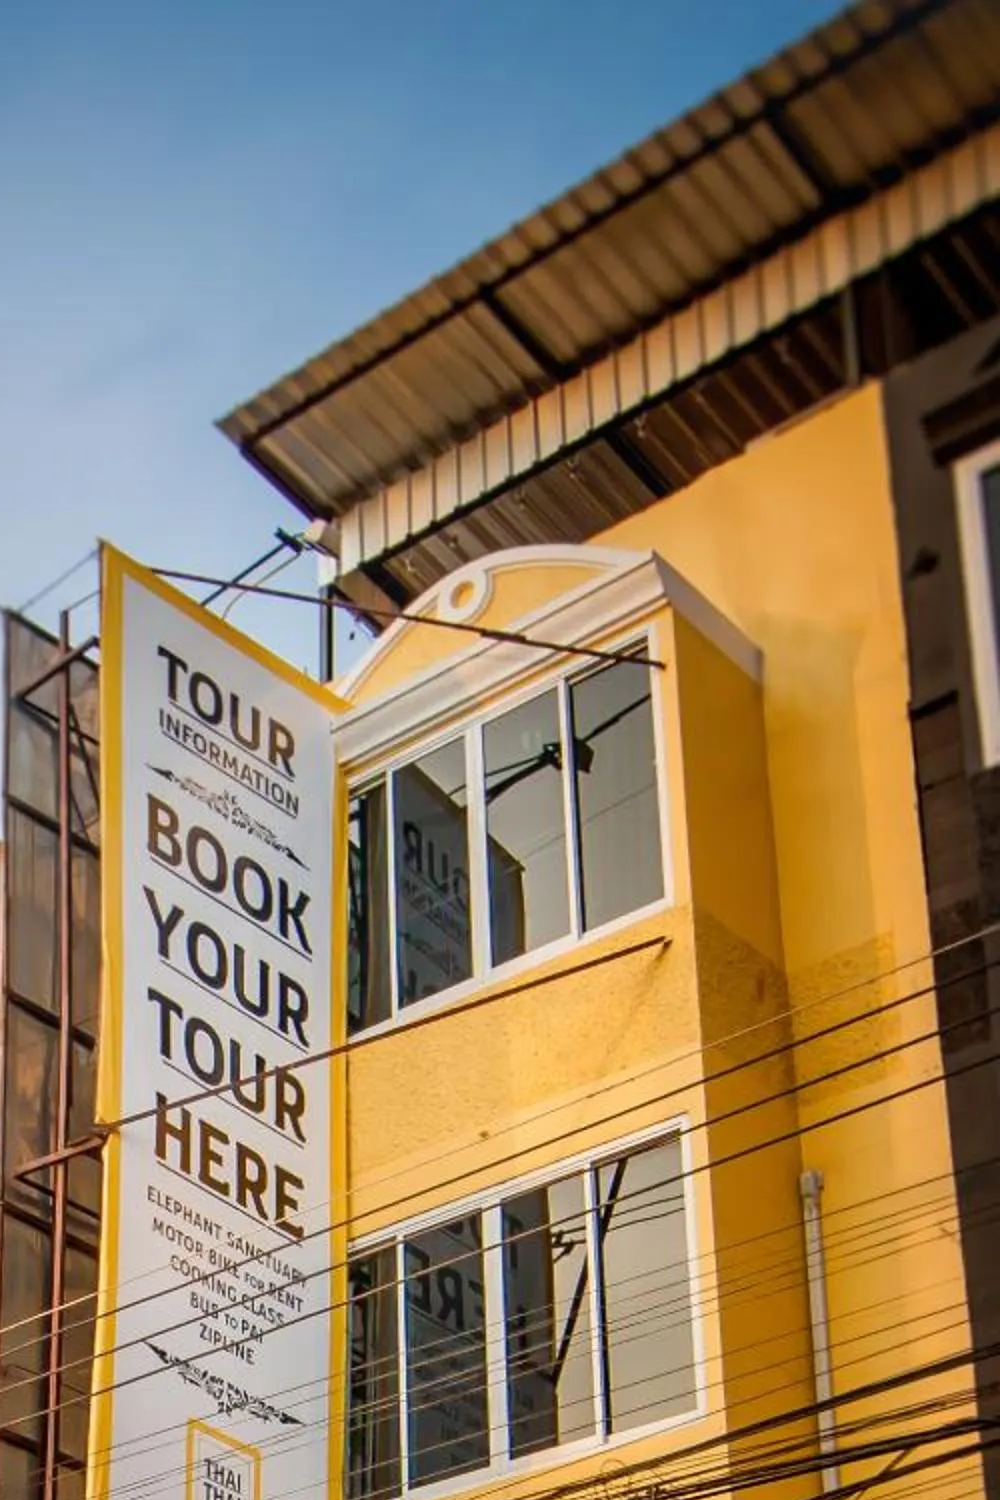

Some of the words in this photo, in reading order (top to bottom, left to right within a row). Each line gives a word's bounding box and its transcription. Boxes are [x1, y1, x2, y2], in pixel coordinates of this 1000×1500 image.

[157, 645, 296, 777] TOUR
[159, 708, 300, 816] INFORMATION
[147, 793, 313, 956] BOOK
[142, 885, 310, 1049] YOUR
[147, 986, 307, 1144] TOUR
[154, 1091, 305, 1239] HERE
[147, 1186, 222, 1240] ELEPHANT
[226, 1231, 307, 1288] SANCTUARY
[152, 1218, 204, 1258] MOTOR
[208, 1249, 241, 1280] BIKE
[244, 1272, 265, 1293] FOR
[268, 1282, 304, 1313] RENT
[170, 1255, 237, 1303] COOKING
[241, 1292, 286, 1326] CLASS
[190, 1291, 220, 1320] BUS
[224, 1313, 240, 1329] TO
[241, 1319, 264, 1345] PAI
[199, 1322, 256, 1366] ZIPLINE
[203, 1458, 242, 1494] THAI
